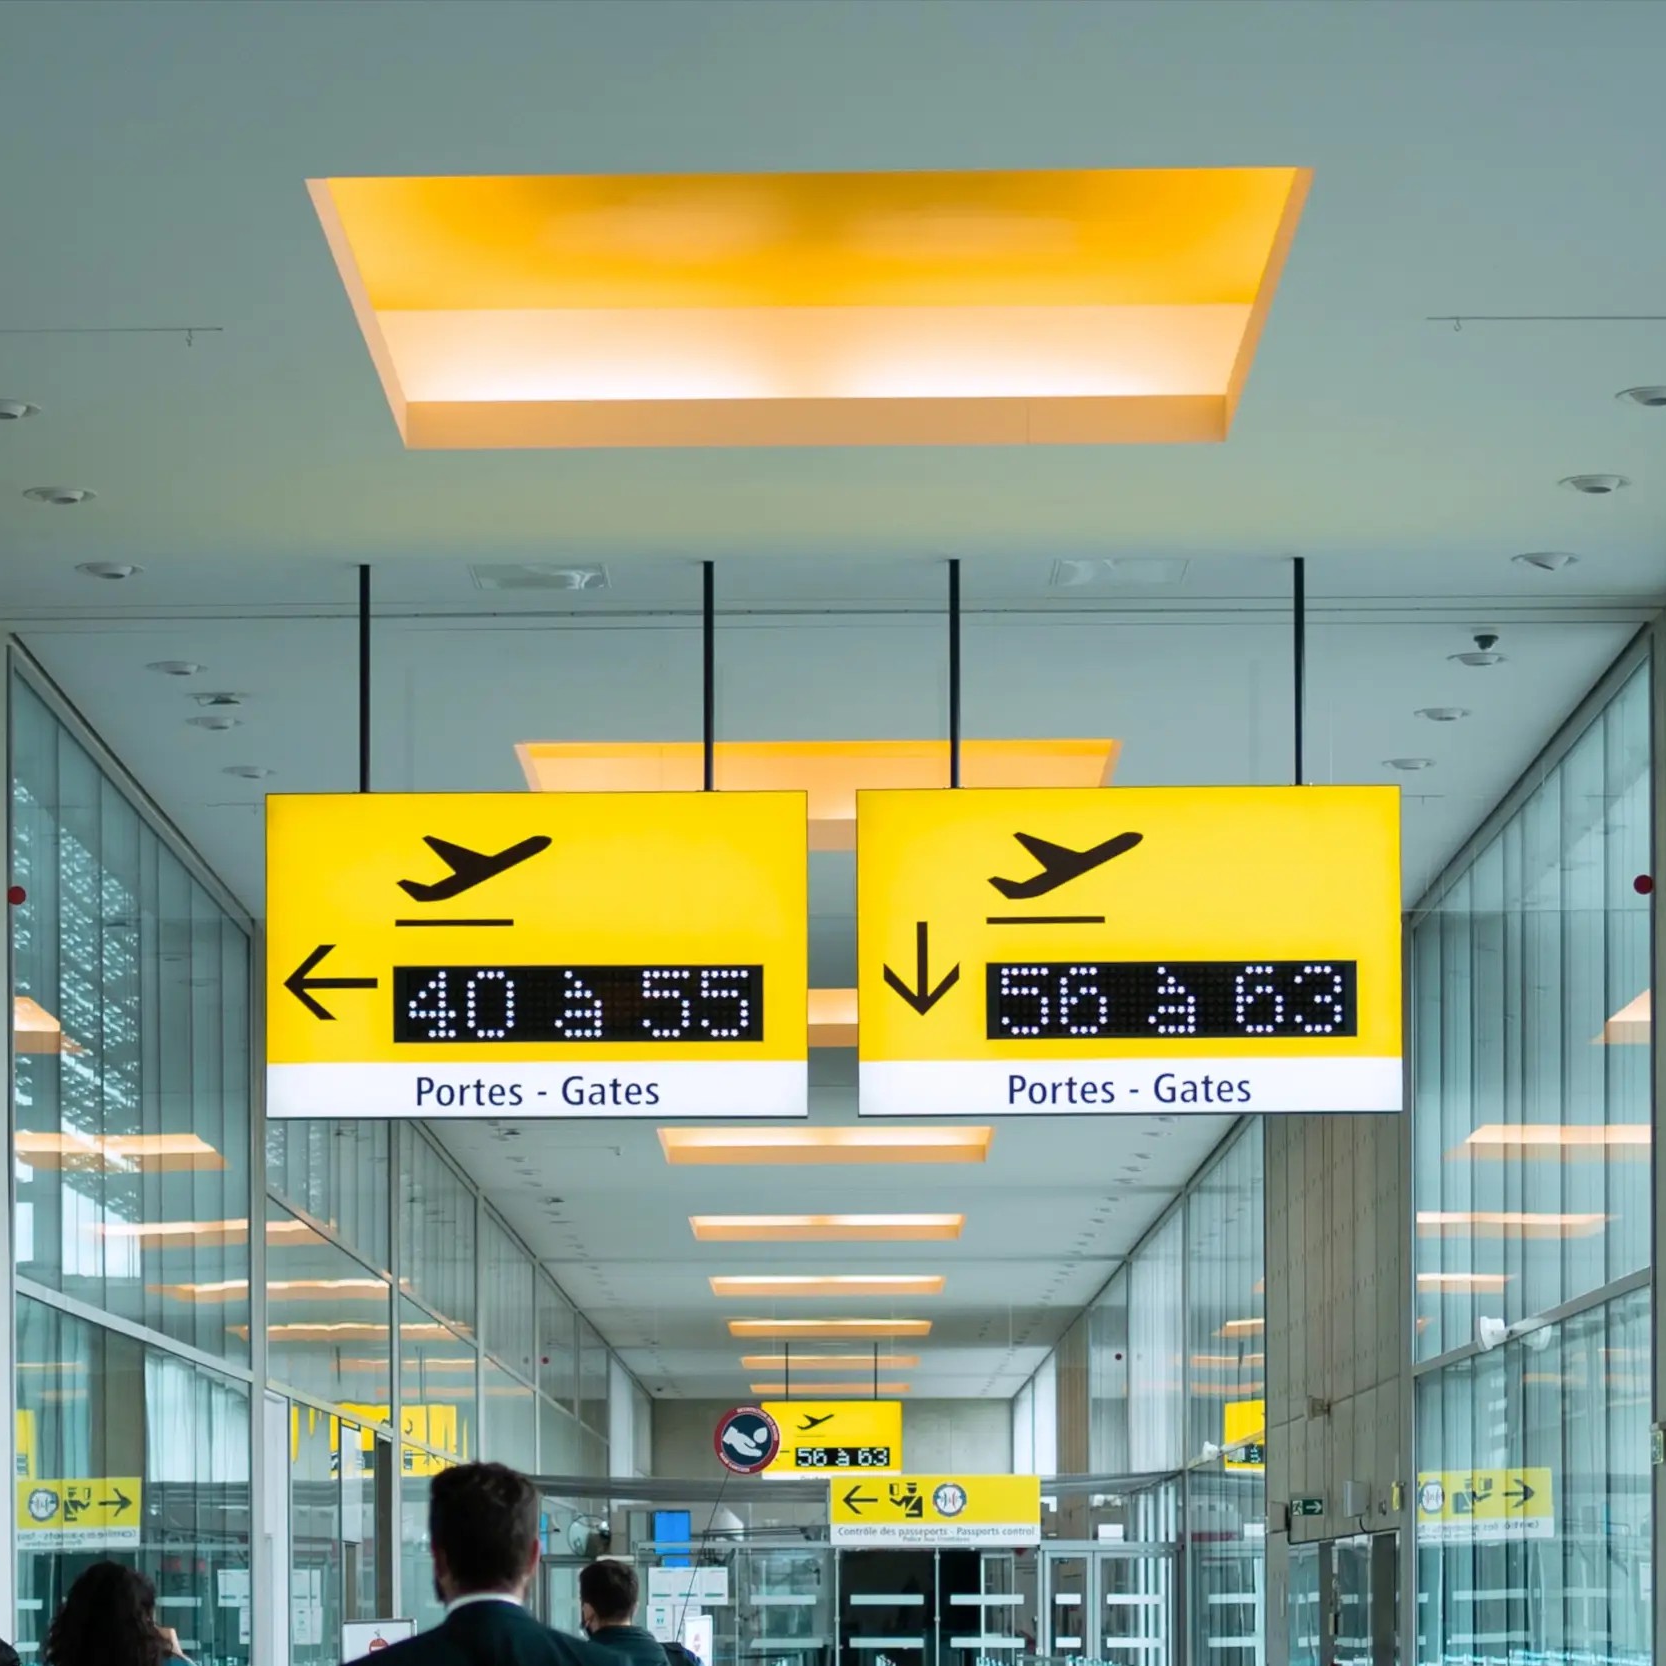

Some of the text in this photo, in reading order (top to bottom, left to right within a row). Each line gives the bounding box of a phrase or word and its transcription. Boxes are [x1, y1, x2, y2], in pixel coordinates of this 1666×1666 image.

[409, 970, 749, 1038] 40 à 55
[1000, 965, 1342, 1034] 56 à 63
[416, 1076, 523, 1106] Portes
[561, 1075, 660, 1106] Gates
[1009, 1074, 1115, 1105] Portes
[1153, 1073, 1252, 1103] Gates
[797, 1447, 828, 1466] 56
[857, 1447, 888, 1466] 63
[837, 1526, 878, 1536] Contrôle
[880, 1526, 896, 1536] des
[898, 1527, 948, 1539] passeports
[956, 1526, 1000, 1538] Passports
[1002, 1526, 1035, 1536] control
